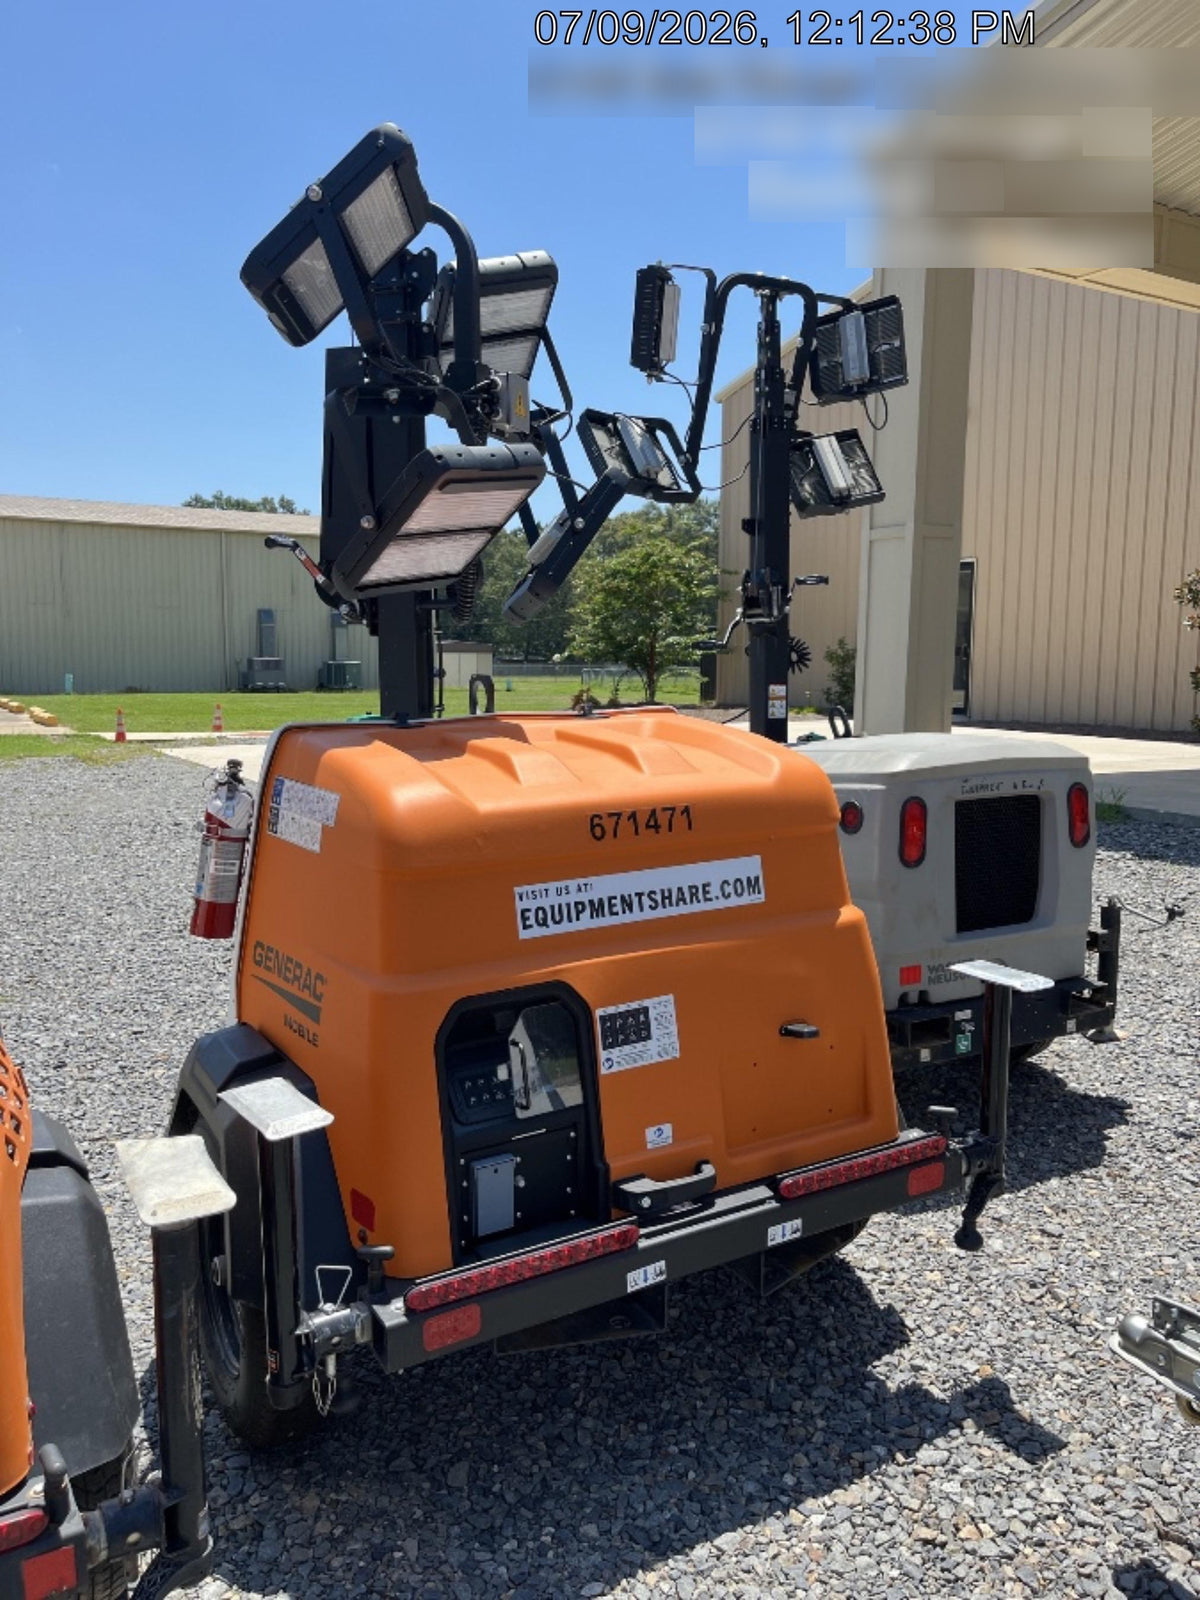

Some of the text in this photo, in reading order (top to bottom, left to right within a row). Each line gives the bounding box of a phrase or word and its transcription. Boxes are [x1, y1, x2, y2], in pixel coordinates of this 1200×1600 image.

[590, 805, 692, 841] 671471
[517, 888, 549, 902] VISIT
[556, 885, 570, 897] US
[520, 875, 762, 930] EQUIPMENTSHARE.COM
[253, 940, 324, 1003] GENERAC
